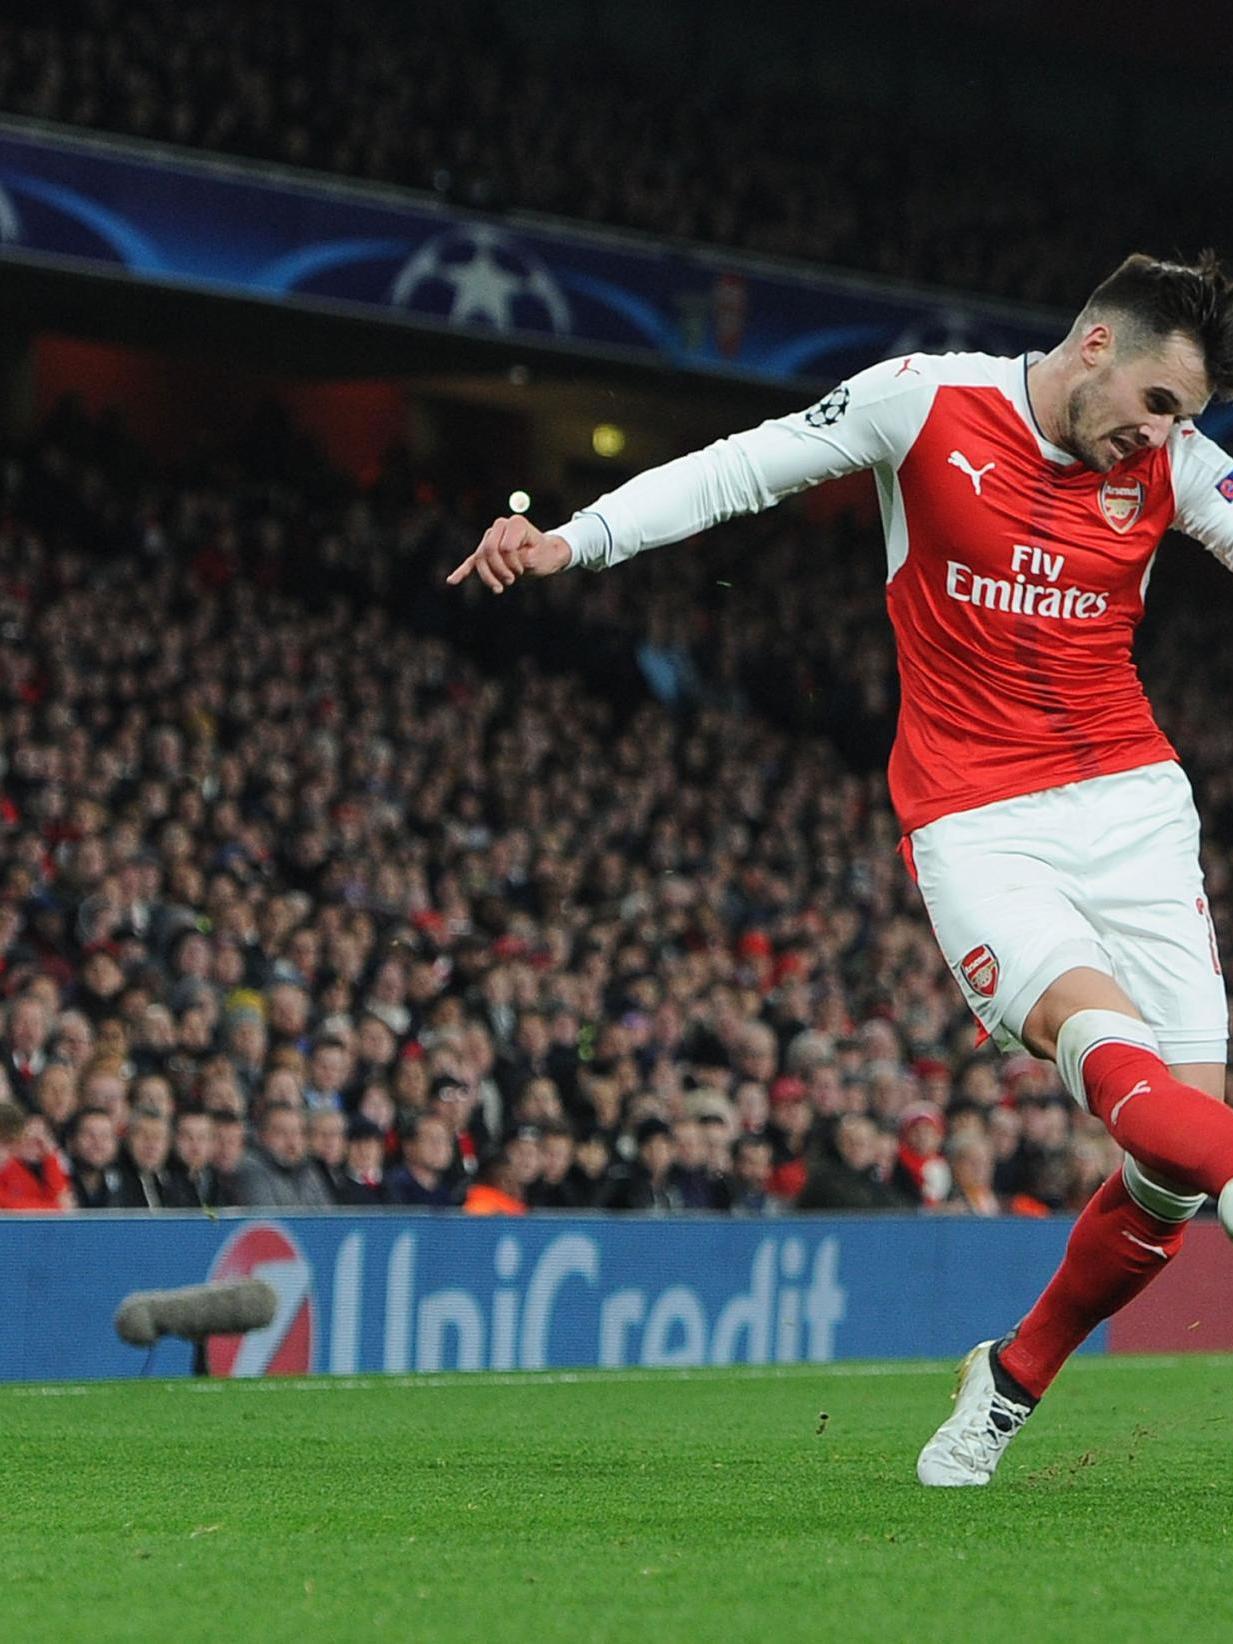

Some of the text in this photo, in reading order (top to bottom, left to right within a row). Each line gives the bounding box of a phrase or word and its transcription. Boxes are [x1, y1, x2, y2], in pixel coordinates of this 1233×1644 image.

[946, 560, 1110, 619] Emirates
[1011, 544, 1065, 582] Fly
[329, 1230, 848, 1373] UniCredit
